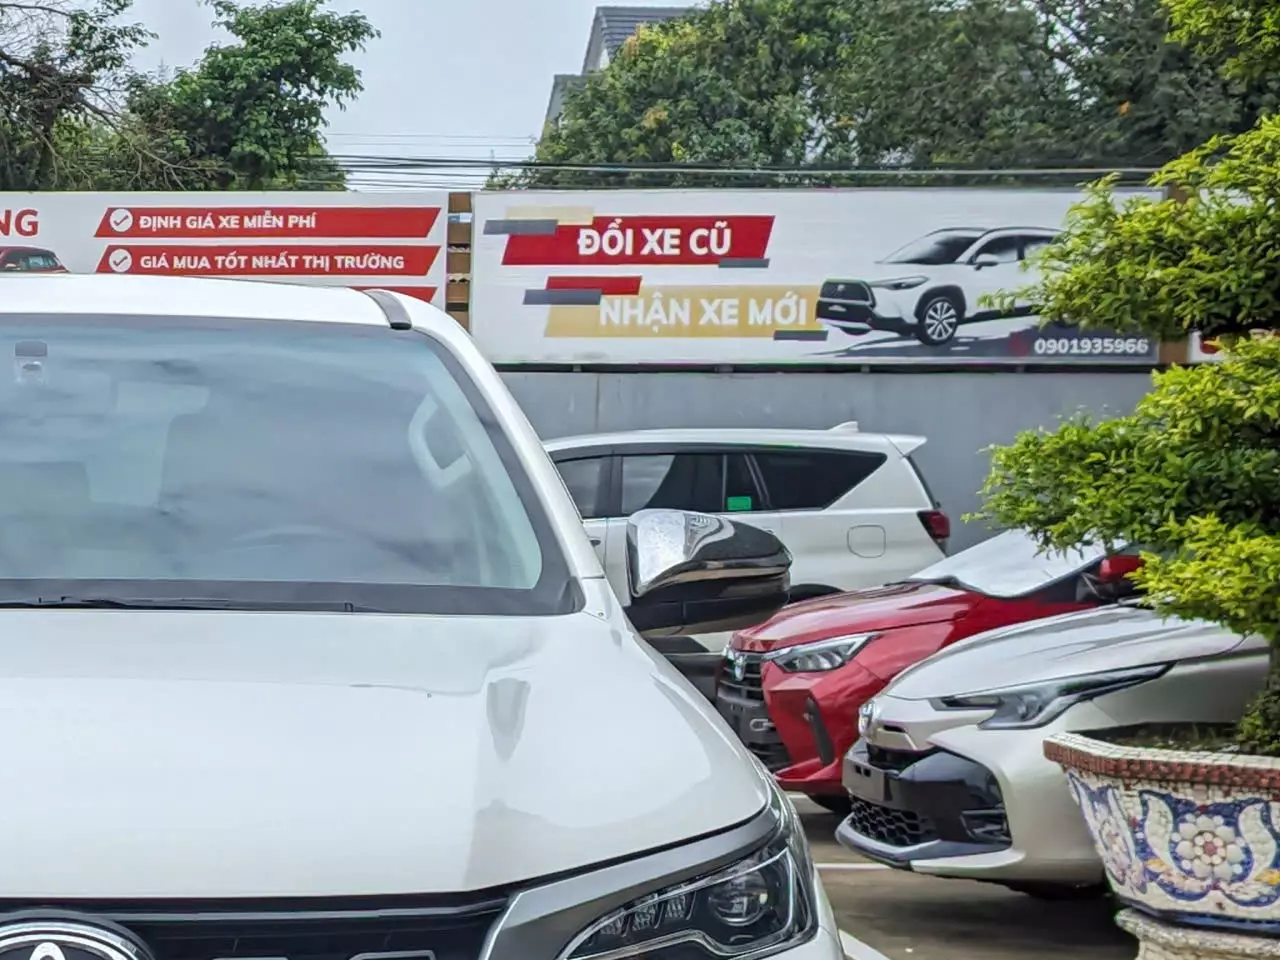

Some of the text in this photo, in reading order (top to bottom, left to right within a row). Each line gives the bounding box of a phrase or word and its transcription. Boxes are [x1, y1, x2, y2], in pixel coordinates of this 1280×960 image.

[139, 210, 317, 231] ĐỊNH GIÁ XE MIỄN PHÍ
[577, 218, 732, 256] ĐỔI XE CŨ
[140, 250, 405, 272] GIÁ MUA TỐT NHẤT THỊ TRƯỜNG
[600, 291, 808, 334] NHẬN XE MỚI
[1034, 337, 1149, 355] 0901935966
